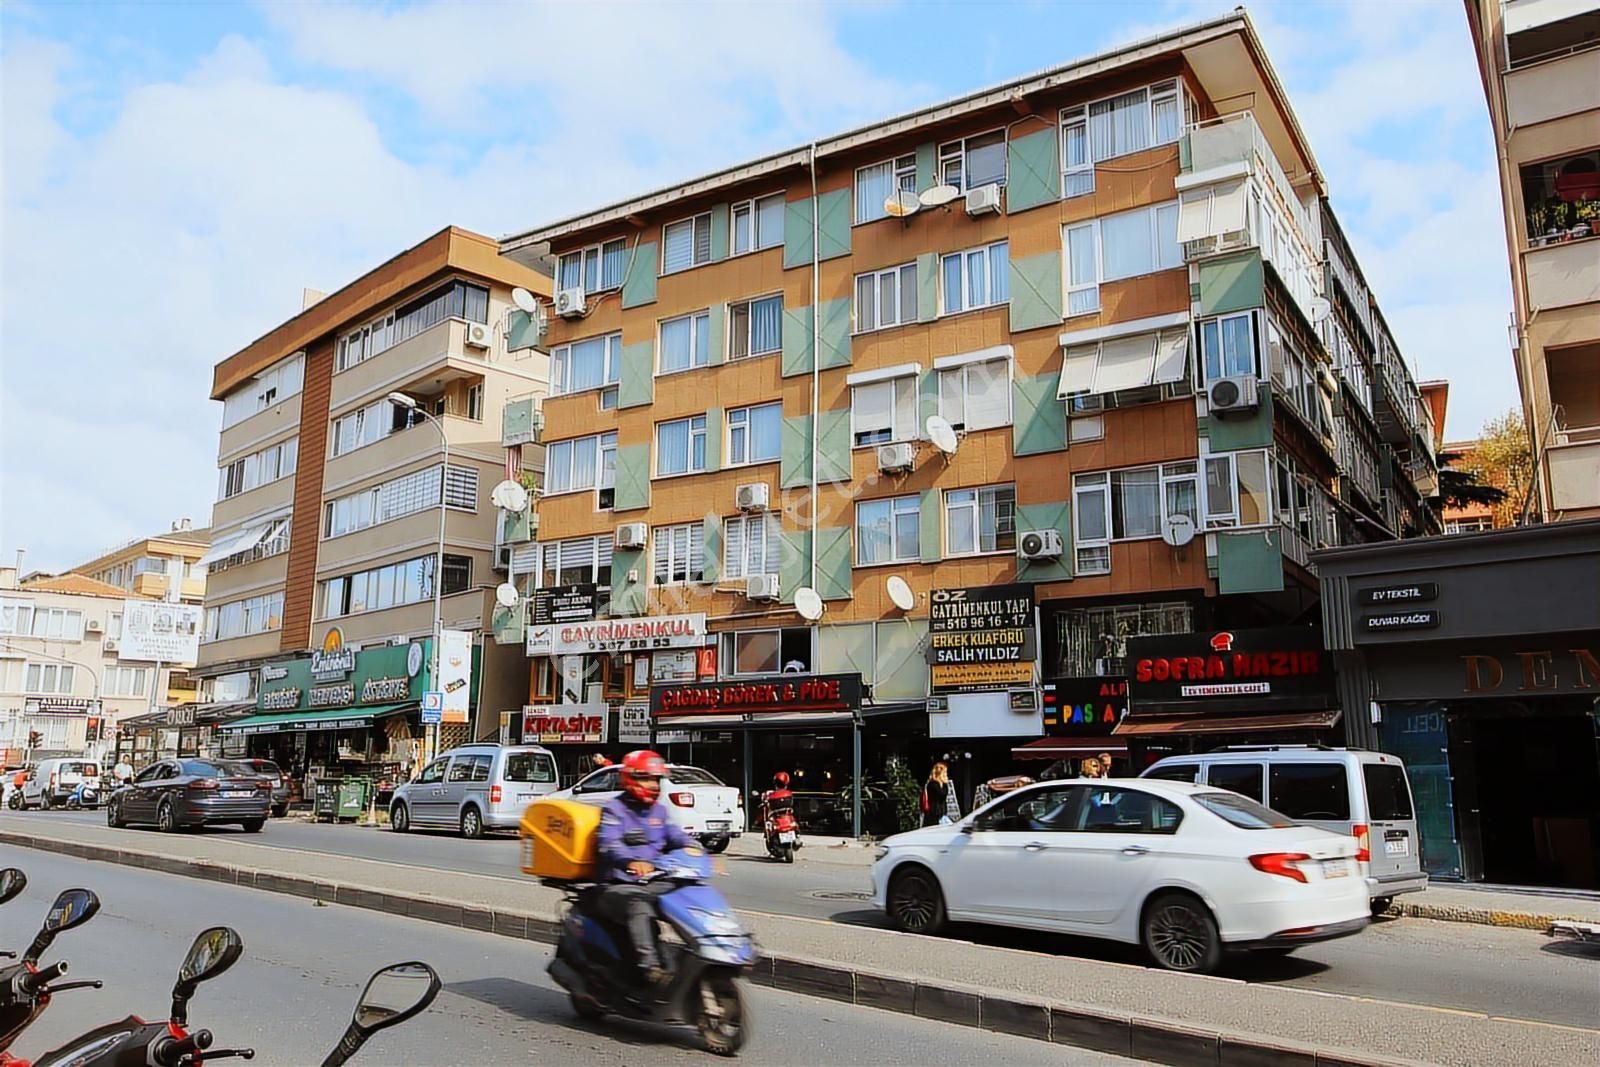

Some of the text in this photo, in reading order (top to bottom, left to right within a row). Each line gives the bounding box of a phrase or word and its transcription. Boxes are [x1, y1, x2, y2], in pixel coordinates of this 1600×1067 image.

[932, 590, 968, 602] ÖZ
[1373, 591, 1386, 600] EV
[932, 598, 1030, 619] GAYRİMENKUL YAPI
[946, 617, 968, 630] 518
[970, 616, 985, 628] 96
[988, 615, 1002, 627] 16
[1011, 613, 1027, 626] 17
[1368, 616, 1400, 627] DUVAR
[933, 628, 1024, 648] ERKEK KUAFÖRÜ
[937, 646, 1020, 662] SALİH YILDIZ
[1137, 650, 1321, 683] SOFRA HAZIR
[662, 685, 722, 712] ÇAĞDAŞ
[722, 682, 779, 703] BÖREK
[799, 678, 841, 701] PİDE
